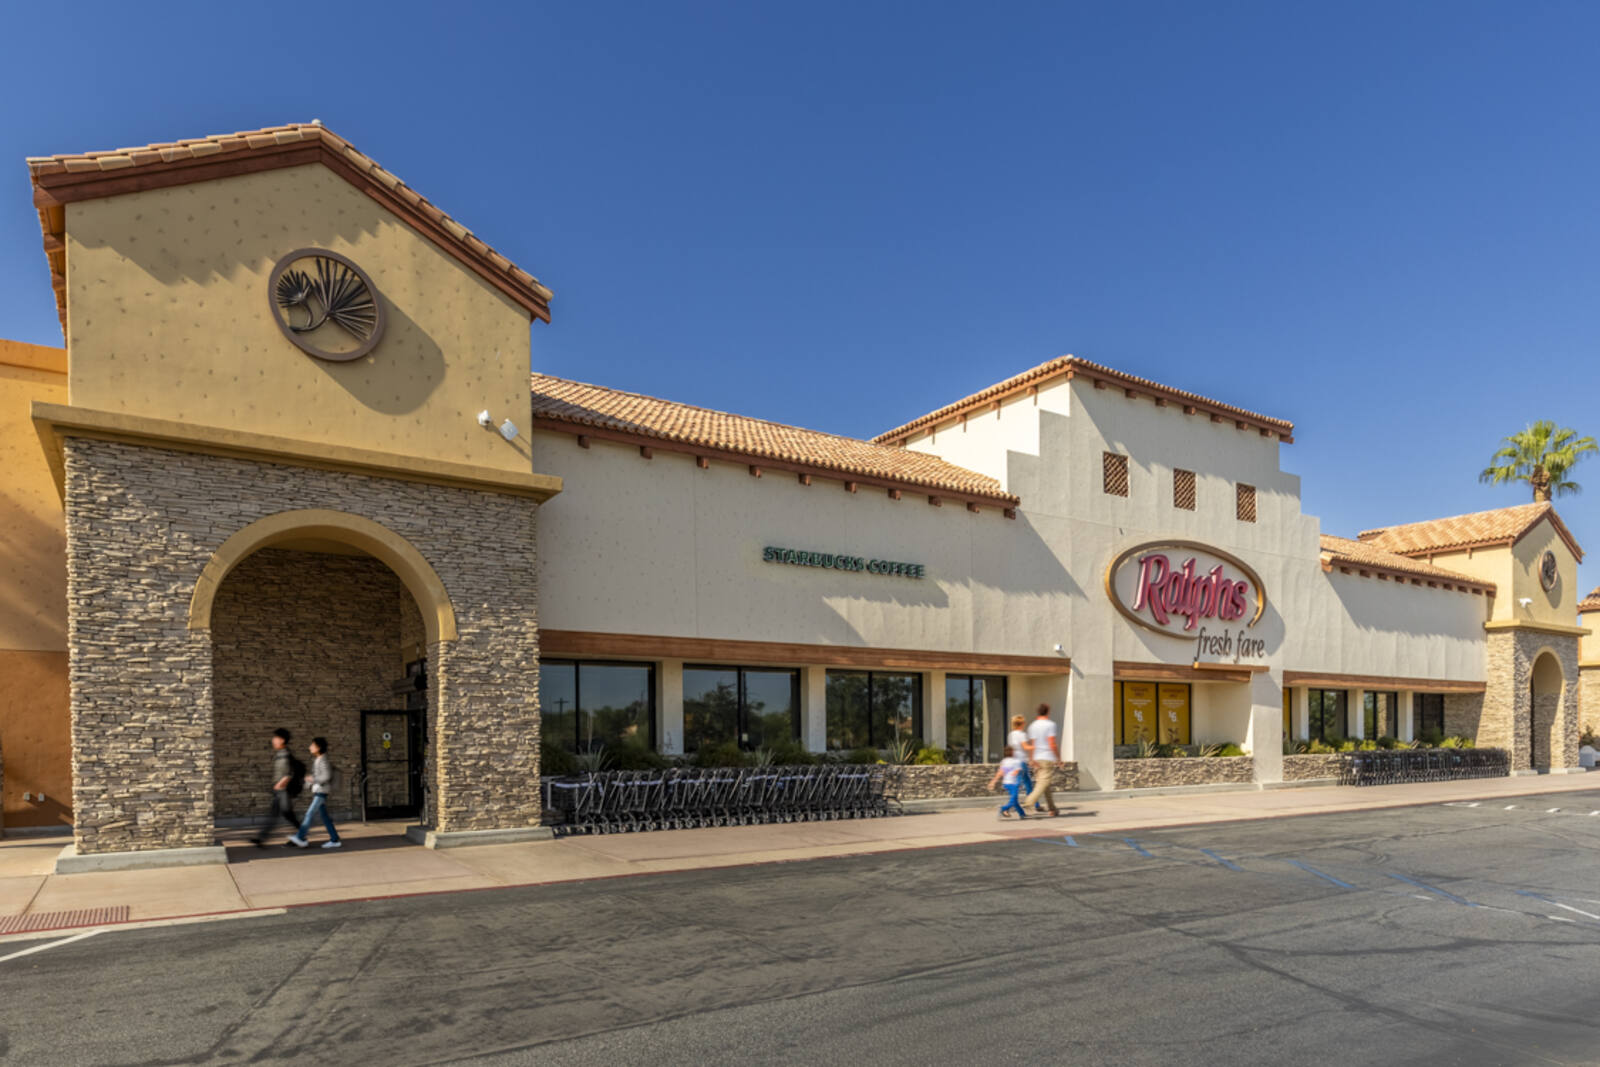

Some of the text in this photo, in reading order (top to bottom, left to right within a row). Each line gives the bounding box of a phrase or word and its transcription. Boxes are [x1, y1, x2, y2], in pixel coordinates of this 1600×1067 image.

[763, 546, 925, 578] STARBUCKS COFFEE
[1132, 554, 1248, 631] Ralphs
[1194, 627, 1265, 663] fresh fare
